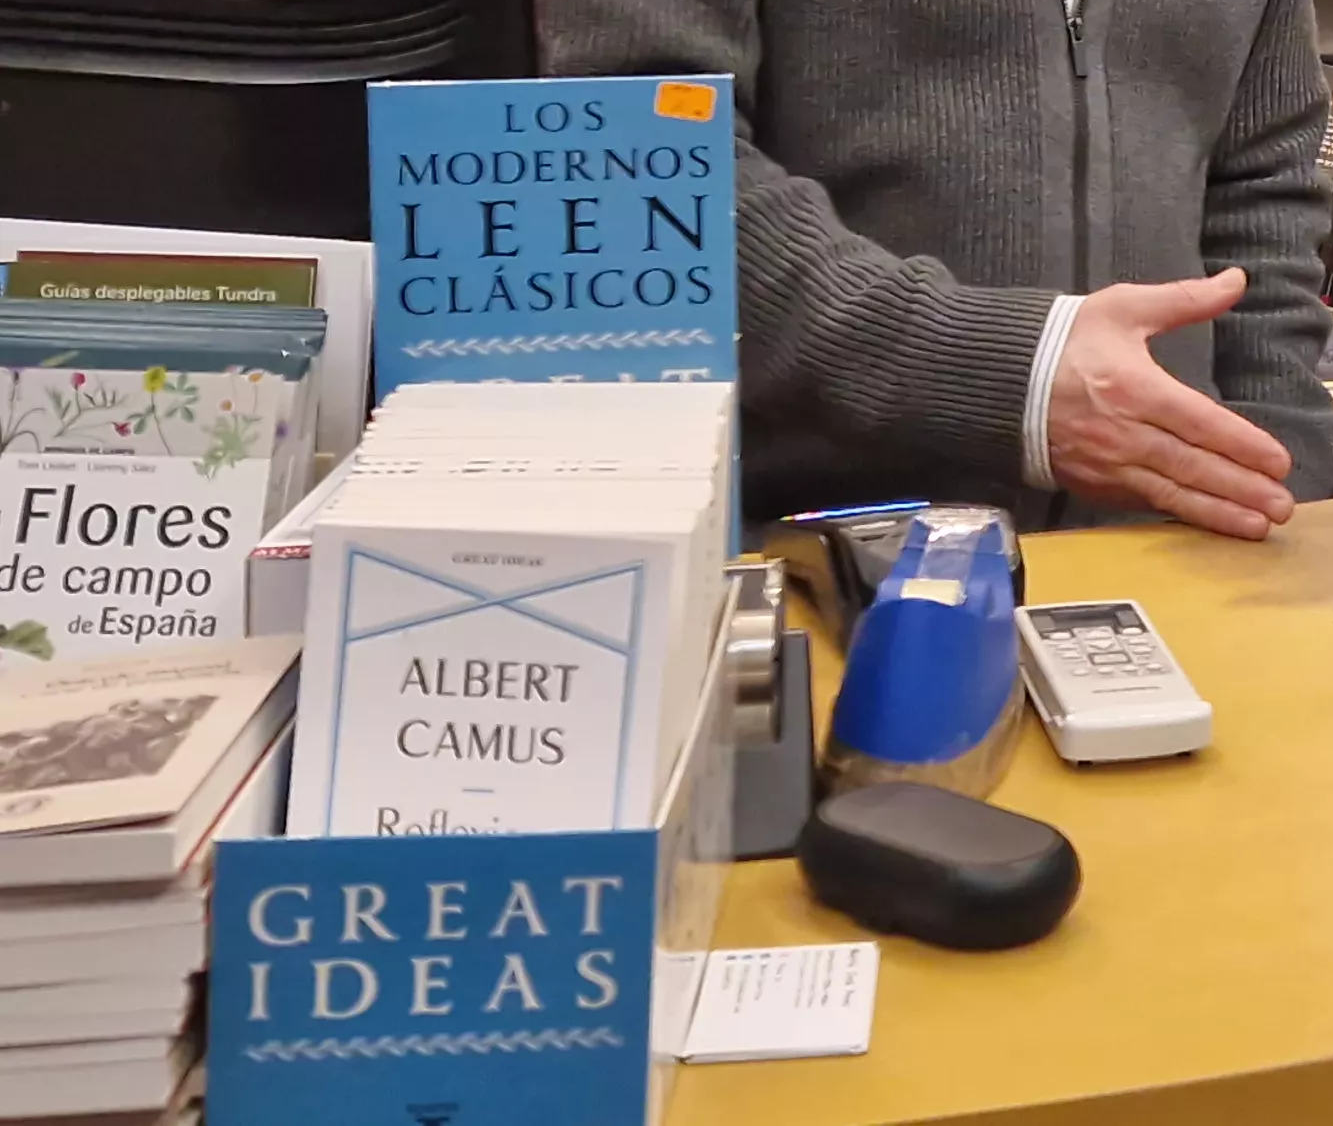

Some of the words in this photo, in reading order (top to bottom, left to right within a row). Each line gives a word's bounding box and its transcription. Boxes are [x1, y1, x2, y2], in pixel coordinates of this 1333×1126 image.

[502, 100, 608, 134] LOS
[398, 145, 711, 187] MODERNOS
[401, 194, 710, 262] LEEN
[40, 283, 90, 300] Guías
[95, 285, 211, 304] desplegables
[215, 285, 278, 302] Tundra
[400, 263, 713, 317] CLÁSICOS
[15, 483, 233, 550] Flores
[62, 561, 213, 607] campo
[68, 614, 94, 636] de
[99, 606, 218, 644] España
[400, 657, 579, 704] ALBERT
[397, 718, 567, 767] CAMUS
[247, 876, 624, 947] GREAT
[246, 948, 620, 1022] IDEAS
